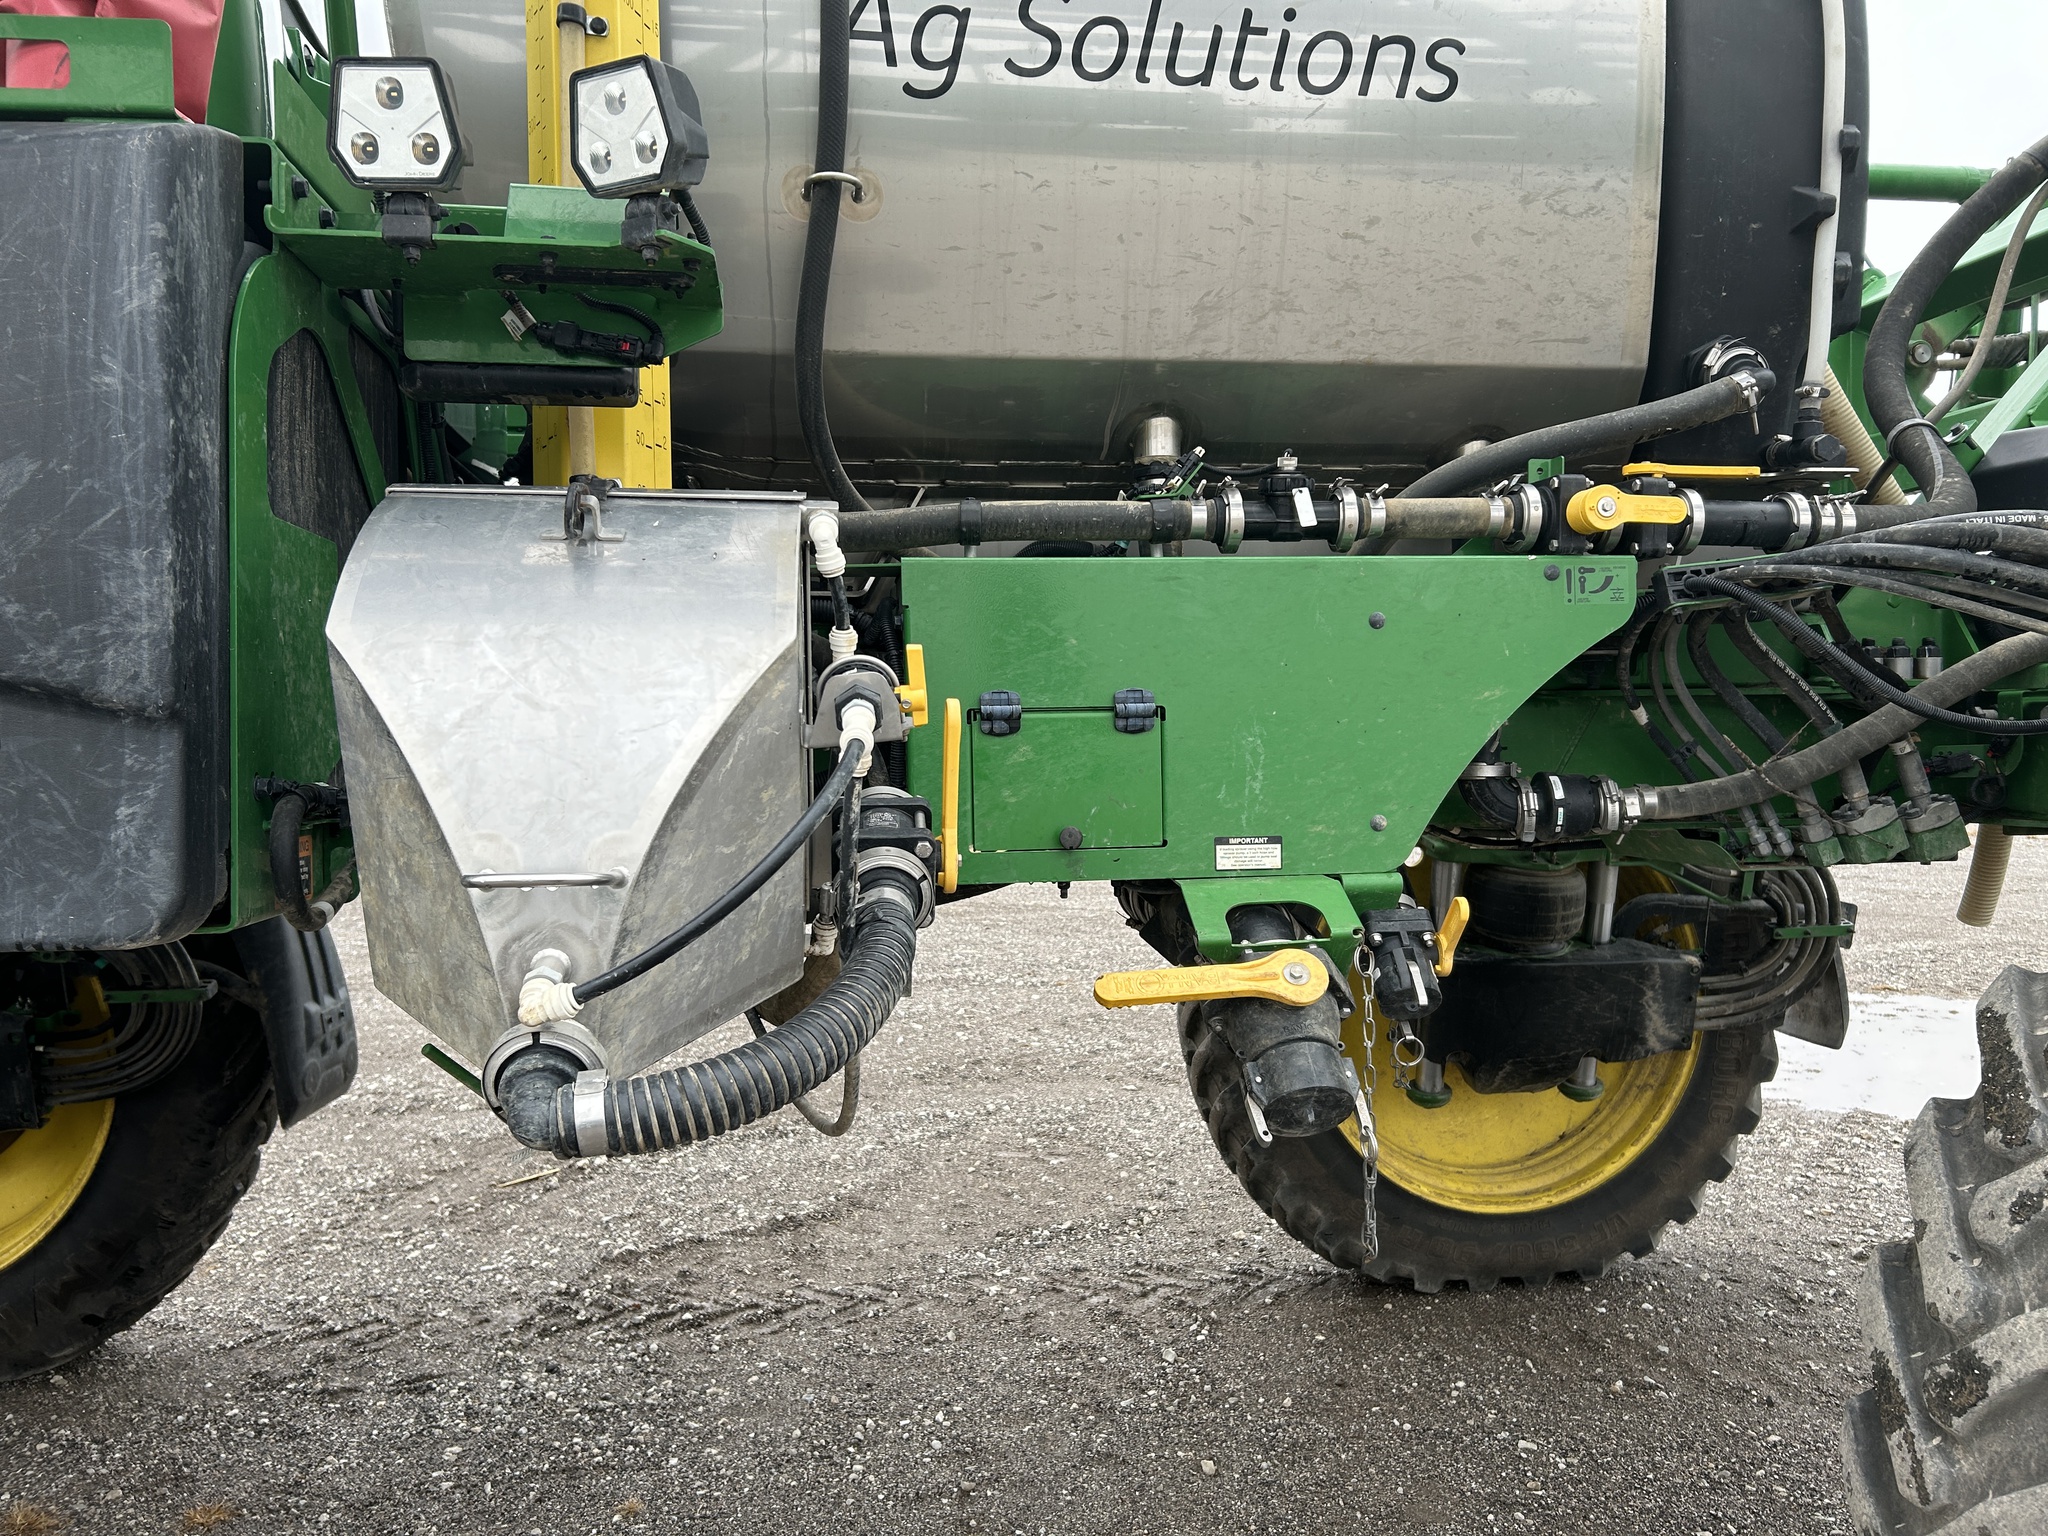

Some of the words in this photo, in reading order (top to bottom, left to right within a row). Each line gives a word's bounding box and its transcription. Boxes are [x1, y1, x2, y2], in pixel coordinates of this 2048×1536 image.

[849, 0, 971, 99] Ag
[1004, 0, 1466, 103] Solutions
[639, 388, 645, 404] 5
[661, 392, 667, 408] 3
[635, 429, 646, 447] 50
[662, 435, 668, 451] 2
[1995, 514, 2006, 524] IN
[2008, 514, 2037, 524] MADE
[1783, 666, 1797, 680] SAE
[1817, 699, 1828, 712] EN
